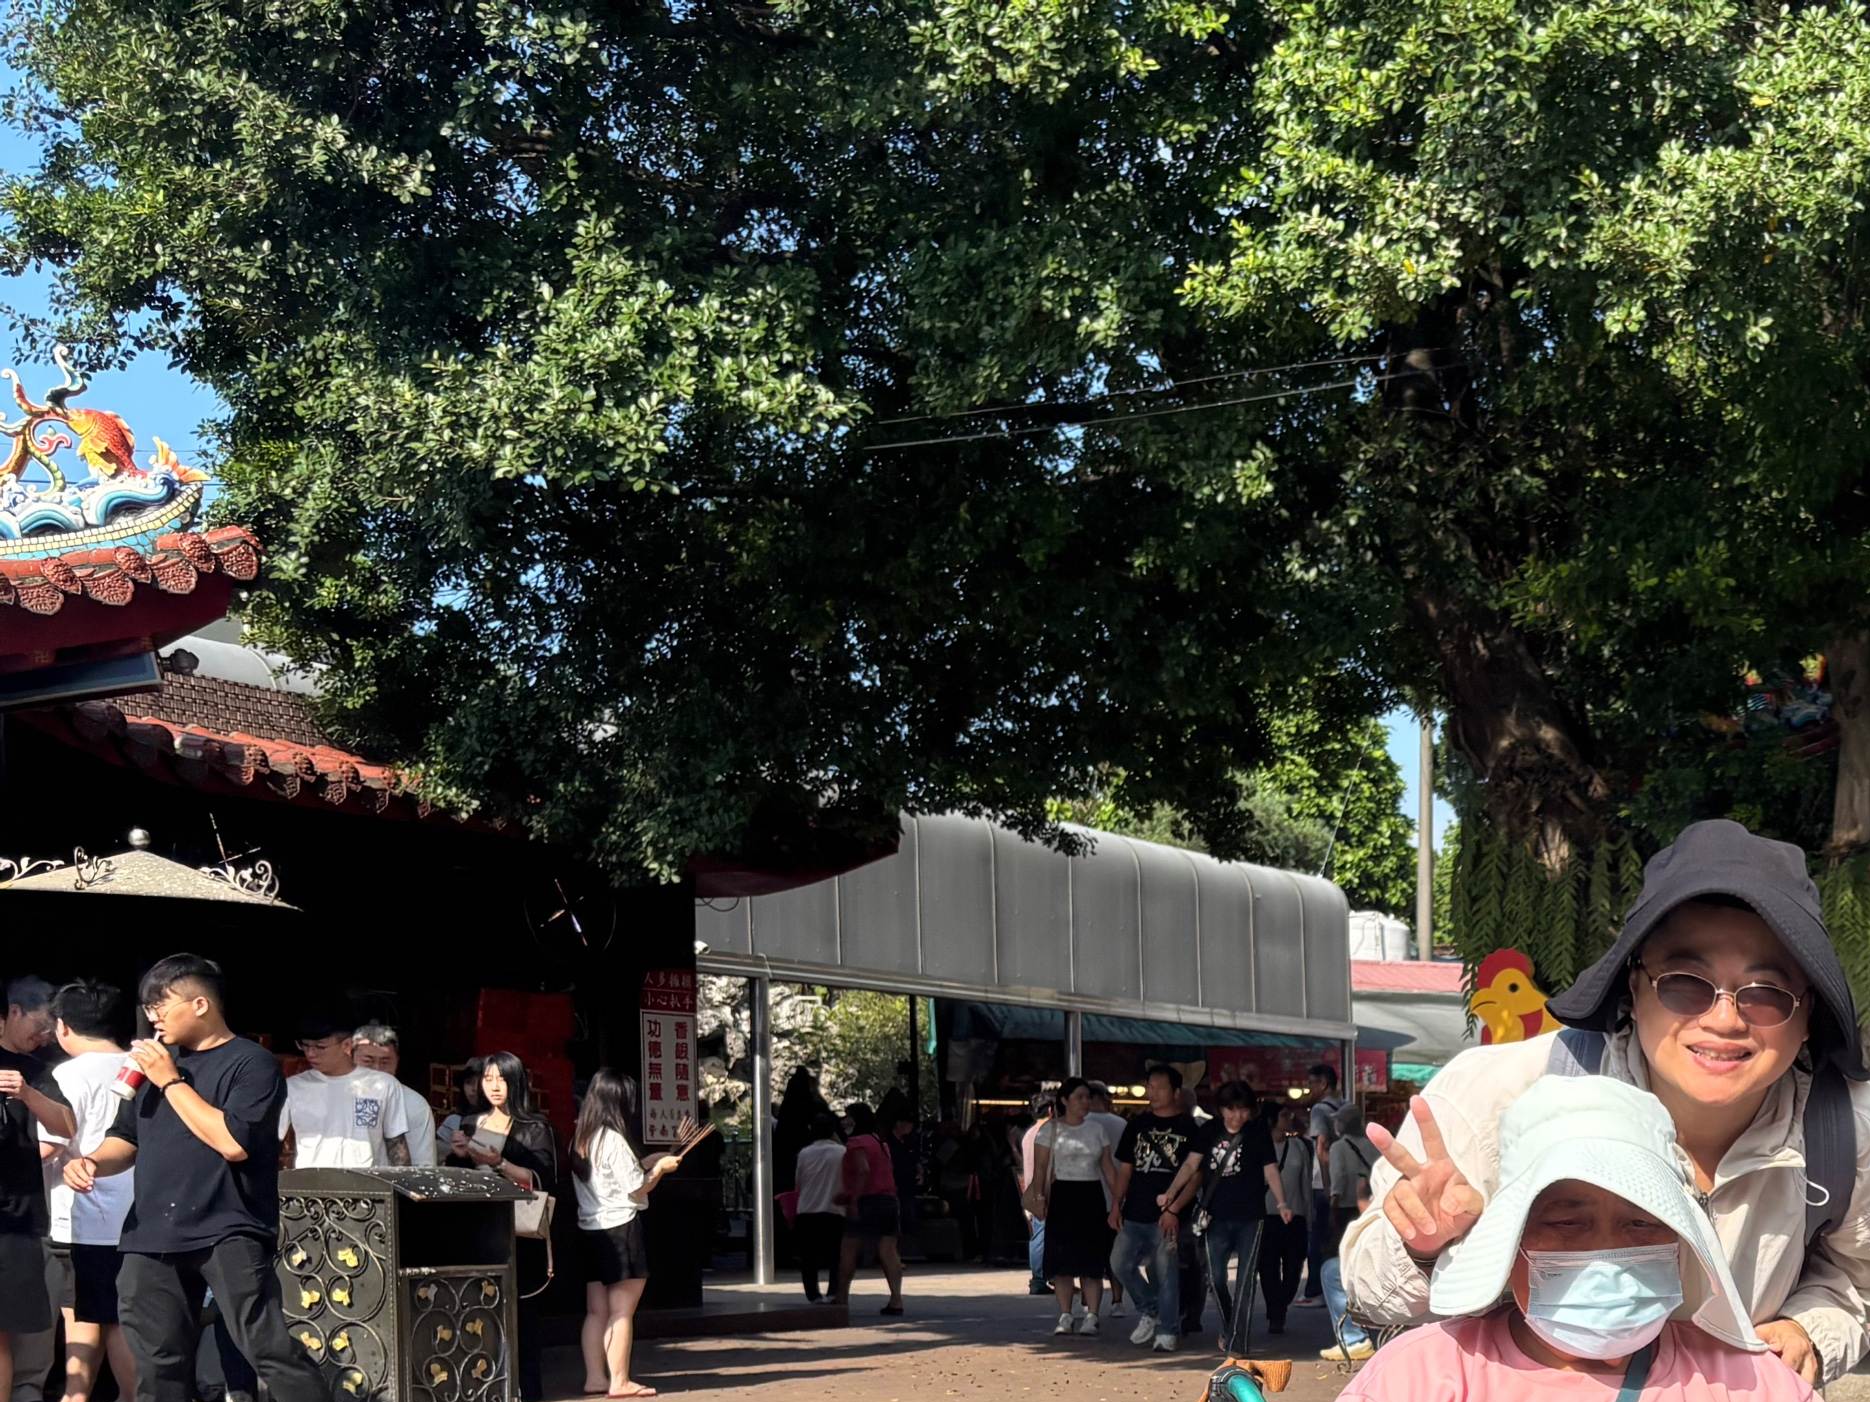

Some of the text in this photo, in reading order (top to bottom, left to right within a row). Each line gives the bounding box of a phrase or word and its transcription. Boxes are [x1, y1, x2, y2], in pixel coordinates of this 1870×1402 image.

[644, 992, 693, 1010] 小心扒手
[647, 1020, 662, 1101] 功德無量
